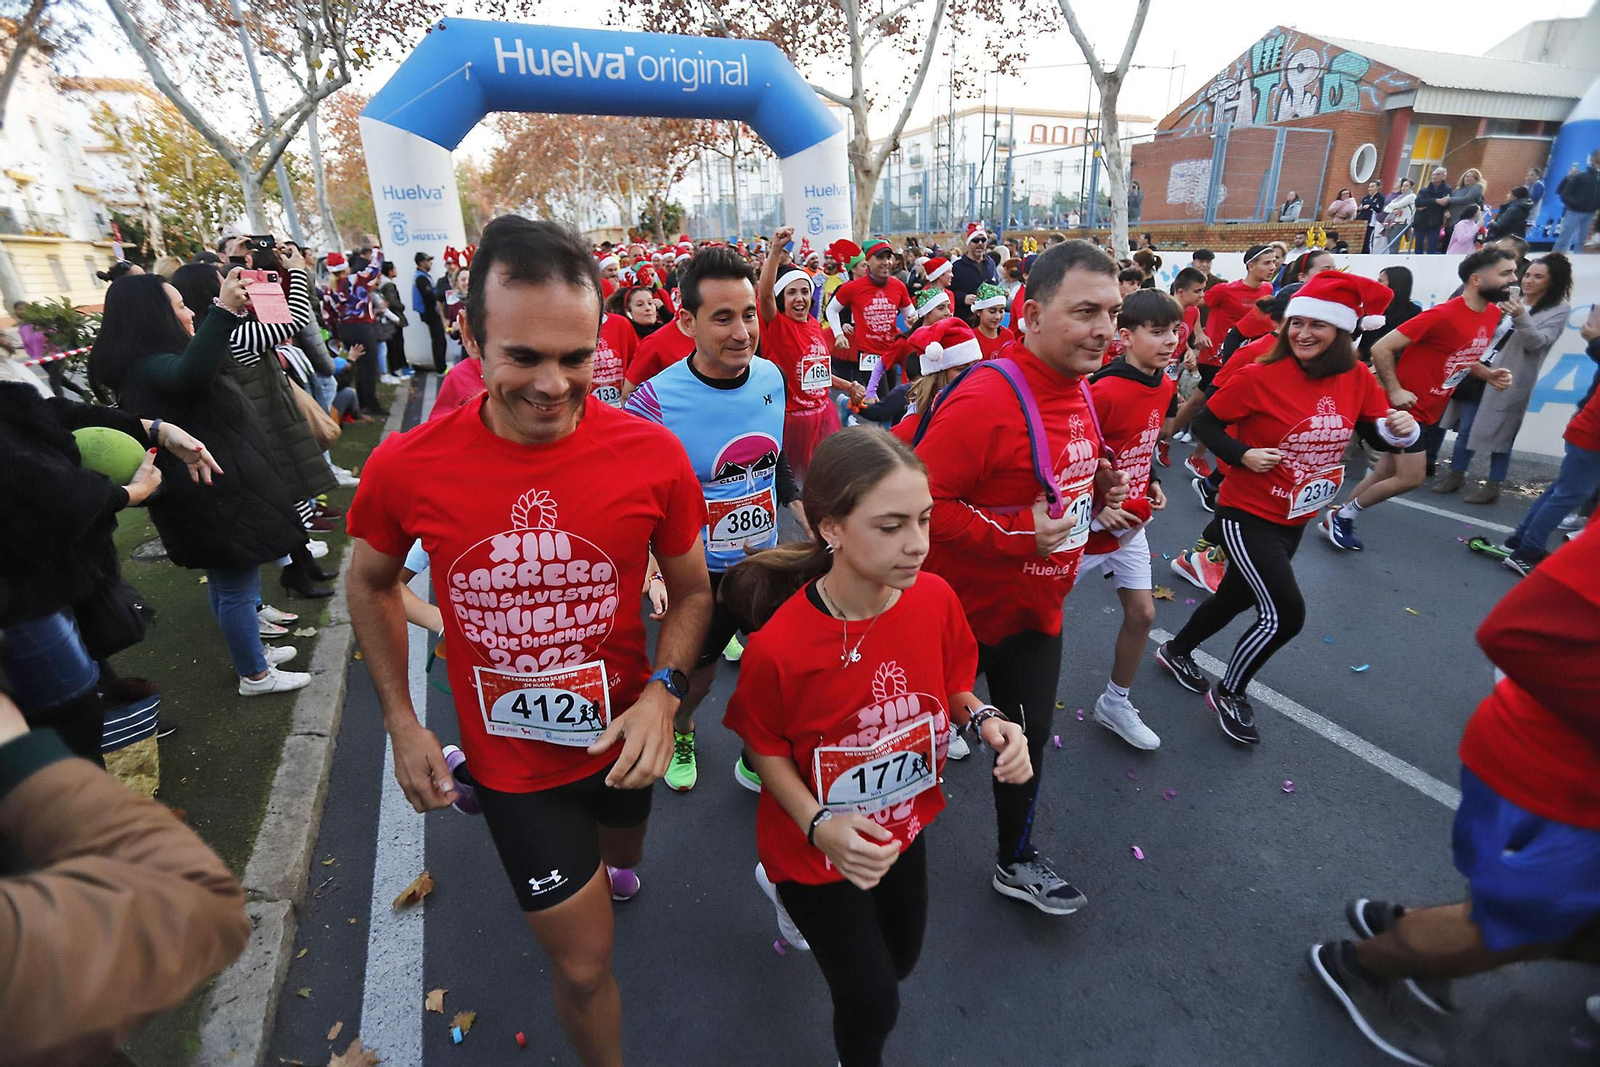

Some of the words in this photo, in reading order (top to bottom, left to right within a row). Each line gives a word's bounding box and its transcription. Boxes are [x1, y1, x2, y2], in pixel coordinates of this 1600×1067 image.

[493, 37, 635, 81] Huelva
[637, 48, 749, 92] original
[382, 184, 446, 200] Huelva
[804, 183, 848, 198] Huelva
[411, 233, 449, 241] HUELVA
[811, 366, 825, 379] 166
[597, 388, 616, 401] 133
[1310, 415, 1343, 429] XIII
[1067, 440, 1093, 463] XIII
[720, 475, 745, 485] CLUB
[1304, 481, 1329, 503] 231
[727, 507, 762, 534] 386
[489, 531, 572, 564] XIII
[452, 560, 612, 592] CARRERA
[1023, 560, 1073, 577] Huelva
[450, 587, 498, 608] SAN
[499, 583, 616, 608] SILVESTRE
[454, 603, 486, 627] DE
[484, 596, 617, 635] HUELVA
[464, 623, 497, 649] 30
[498, 636, 521, 651] DE
[521, 623, 607, 648] DICIEMBRE
[489, 644, 586, 674] 2023
[550, 672, 578, 681] SILVESTRE
[511, 693, 576, 723] 412
[857, 692, 921, 729] XIII
[852, 752, 909, 794] 177
